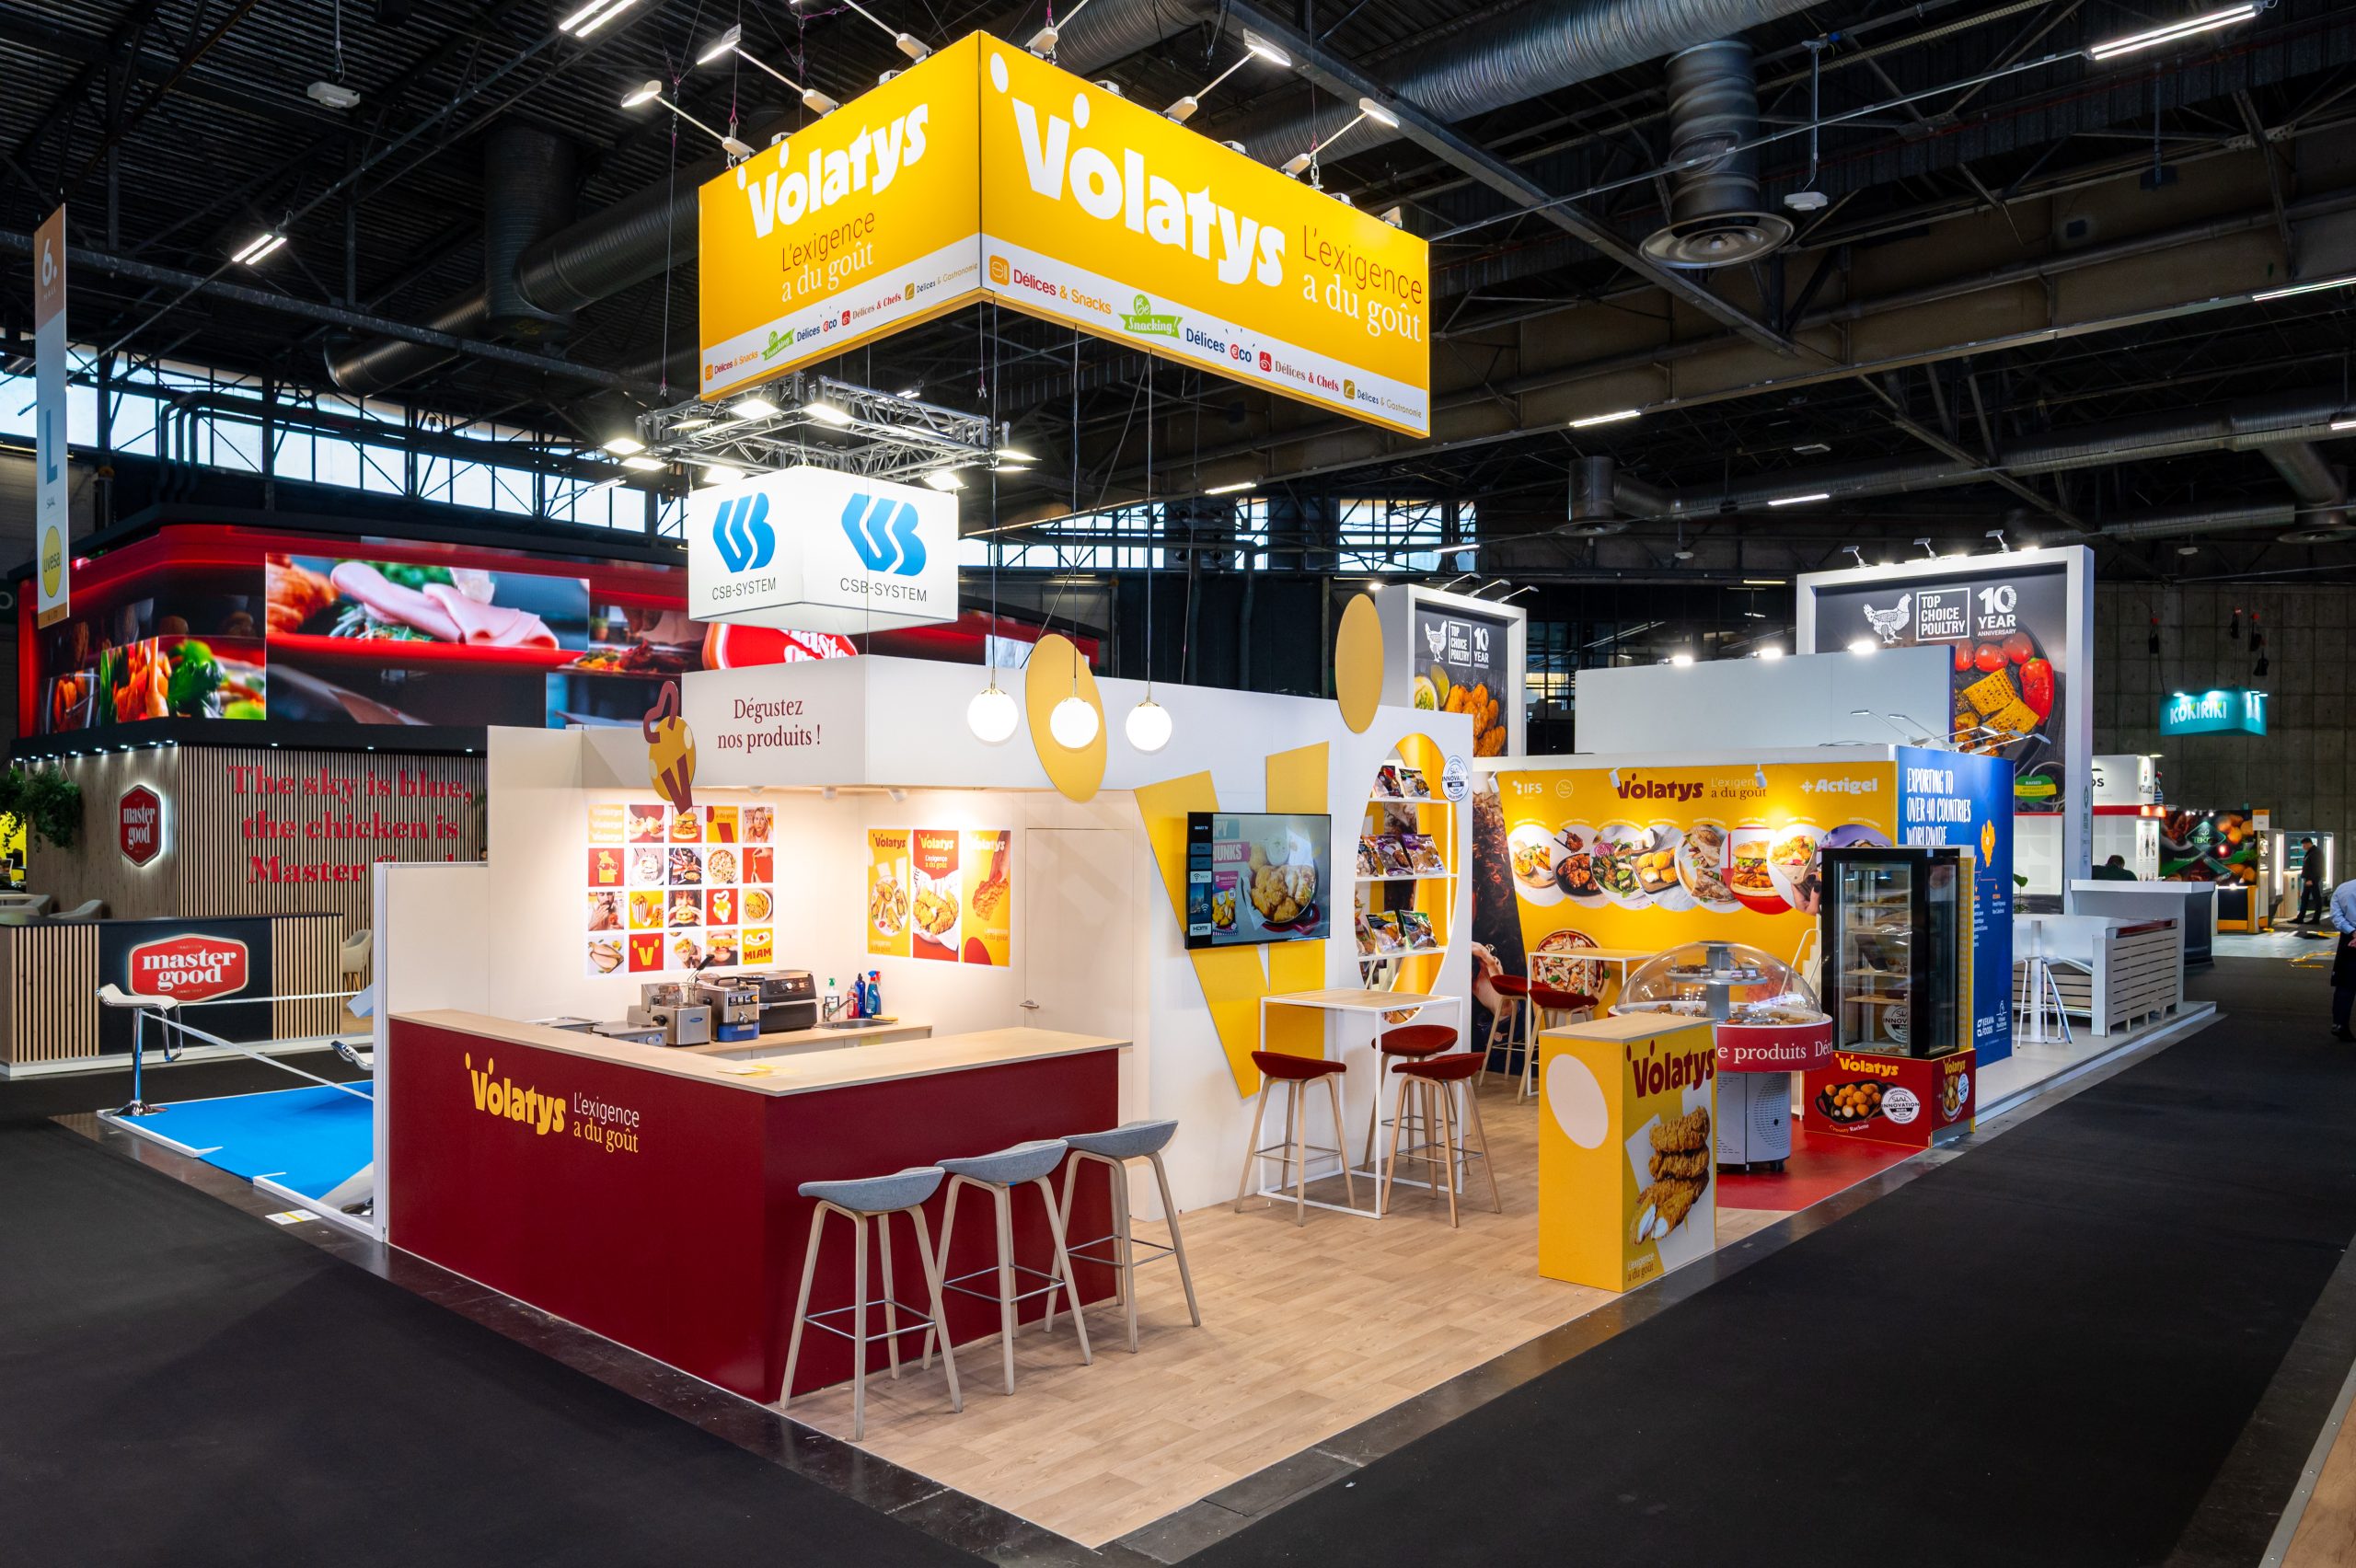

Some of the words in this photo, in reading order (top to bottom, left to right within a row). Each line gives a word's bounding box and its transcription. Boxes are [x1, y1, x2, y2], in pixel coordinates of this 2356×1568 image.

[746, 103, 929, 239] Volatys
[1011, 93, 1286, 287] Volatys
[782, 212, 875, 271] L'exigence
[781, 281, 792, 303] a
[797, 263, 823, 295] du
[827, 240, 874, 291] goût
[1303, 224, 1423, 305] L'exigence
[916, 279, 936, 294] Délices
[942, 262, 978, 283] Gastronomie
[1013, 269, 1057, 296] Délices
[1059, 285, 1068, 300] &
[1071, 288, 1113, 315] Snacks
[852, 304, 875, 321] Délices
[883, 293, 902, 308] Chefs
[1302, 273, 1319, 304] a
[1325, 273, 1360, 320] du
[1367, 302, 1423, 343] goût
[796, 325, 821, 343] Délices
[1128, 316, 1179, 336] Snacking!
[1185, 328, 1226, 353] Délices
[714, 360, 733, 375] Délices
[739, 350, 759, 366] Snacks
[1275, 360, 1306, 382] Délices
[1308, 373, 1315, 385] &
[1317, 375, 1340, 392] Chefs
[1357, 388, 1380, 406] Délices
[1386, 398, 1423, 420] Gastronomie
[46, 409, 58, 486] L
[711, 576, 777, 601] CSB-SYSTEM
[839, 577, 928, 603] CSB-SYSTEM
[1977, 585, 2017, 615] 10
[1921, 594, 1942, 609] TOP
[1921, 606, 1960, 622] CHOICE
[1450, 625, 1460, 638] TOP
[1921, 620, 1966, 636] POULTRY
[1977, 614, 2016, 629] YEAR
[1977, 628, 2017, 637] ANNIVERSARY
[1450, 639, 1468, 650] CHOICE
[1473, 627, 1490, 651] 10
[1450, 651, 1470, 663] POULTRY
[1473, 650, 1489, 663] YEAR
[733, 698, 803, 724] Dégustez
[2169, 701, 2227, 725] KOKIRIKI
[718, 732, 743, 749] nos
[747, 723, 812, 754] produits
[225, 765, 294, 794] The
[303, 767, 359, 804] sky
[366, 769, 391, 797] is
[398, 768, 472, 804] blue,
[1524, 782, 1543, 794] IFS
[1617, 779, 1704, 802] Volatys
[1711, 789, 1717, 798] a
[1720, 786, 1737, 798] du
[1815, 777, 1878, 795] Actigel
[1907, 767, 1944, 794] EXPORTING
[1945, 769, 1954, 795] TO
[122, 802, 156, 824] master
[1907, 796, 1925, 823] OVER
[1926, 797, 1935, 823] 40
[1936, 798, 1971, 824] COUNTRIES
[127, 821, 151, 850] good
[242, 810, 297, 839] the
[305, 811, 429, 839] chicken
[435, 813, 459, 839] is
[875, 836, 907, 849] Volatys
[920, 836, 954, 851] Volatys
[246, 855, 366, 883] Master
[143, 947, 237, 971] master
[744, 947, 772, 961] MIAM
[157, 963, 223, 992] good
[1733, 1043, 1807, 1064] produits
[1632, 1042, 1716, 1100] Volatys
[1839, 1055, 1900, 1078] Volatys
[1944, 1059, 1966, 1075] Volatys
[470, 1058, 566, 1136] Volatys
[573, 1091, 640, 1128] L'exigence
[573, 1120, 582, 1138] a
[584, 1117, 603, 1144] du
[606, 1127, 639, 1153] goût
